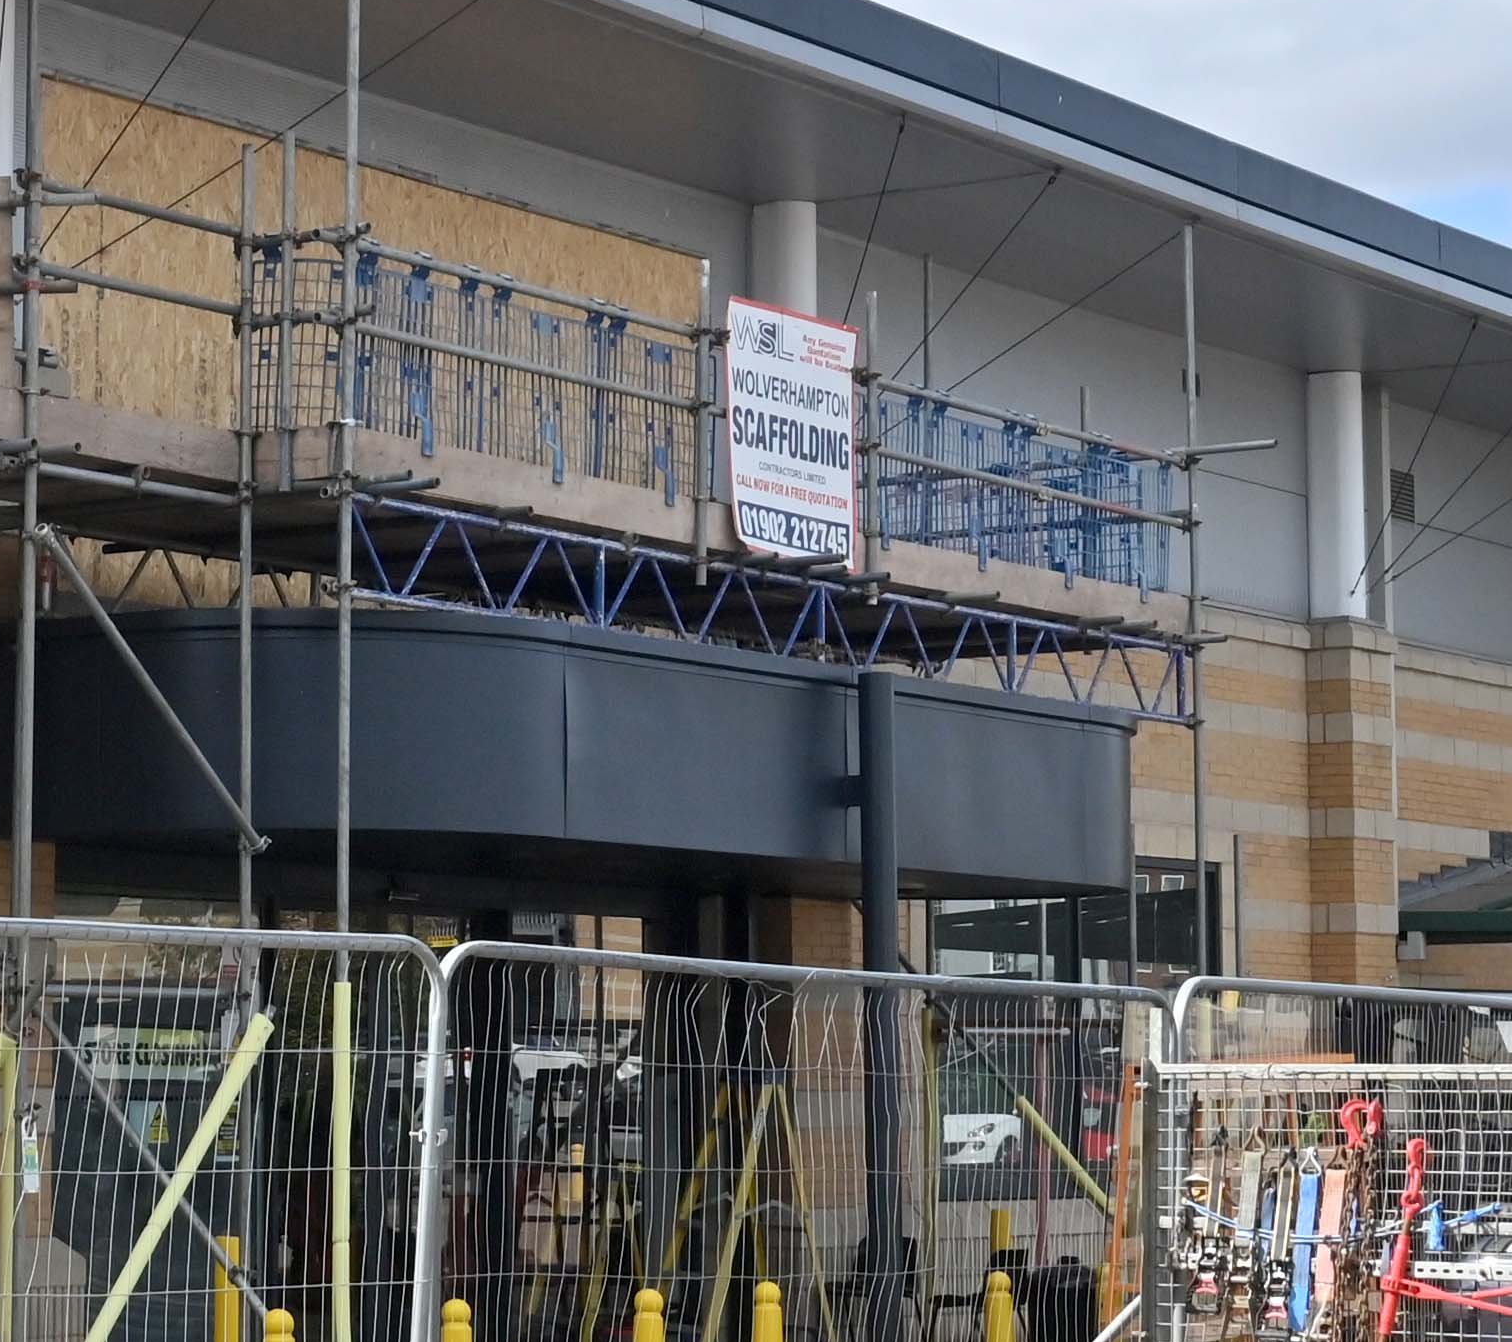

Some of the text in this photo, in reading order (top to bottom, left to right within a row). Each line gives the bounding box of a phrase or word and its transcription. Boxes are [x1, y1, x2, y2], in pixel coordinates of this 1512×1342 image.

[731, 313, 794, 362] WSL
[731, 366, 850, 419] WOLVERHAMPTON
[732, 405, 850, 471] SCAFFOLDING
[736, 473, 849, 510] CALL NOW FOR A FREE QUOTATION
[758, 461, 827, 485] CONTRACTORS LIMITED
[741, 504, 847, 556] 01902 212745
